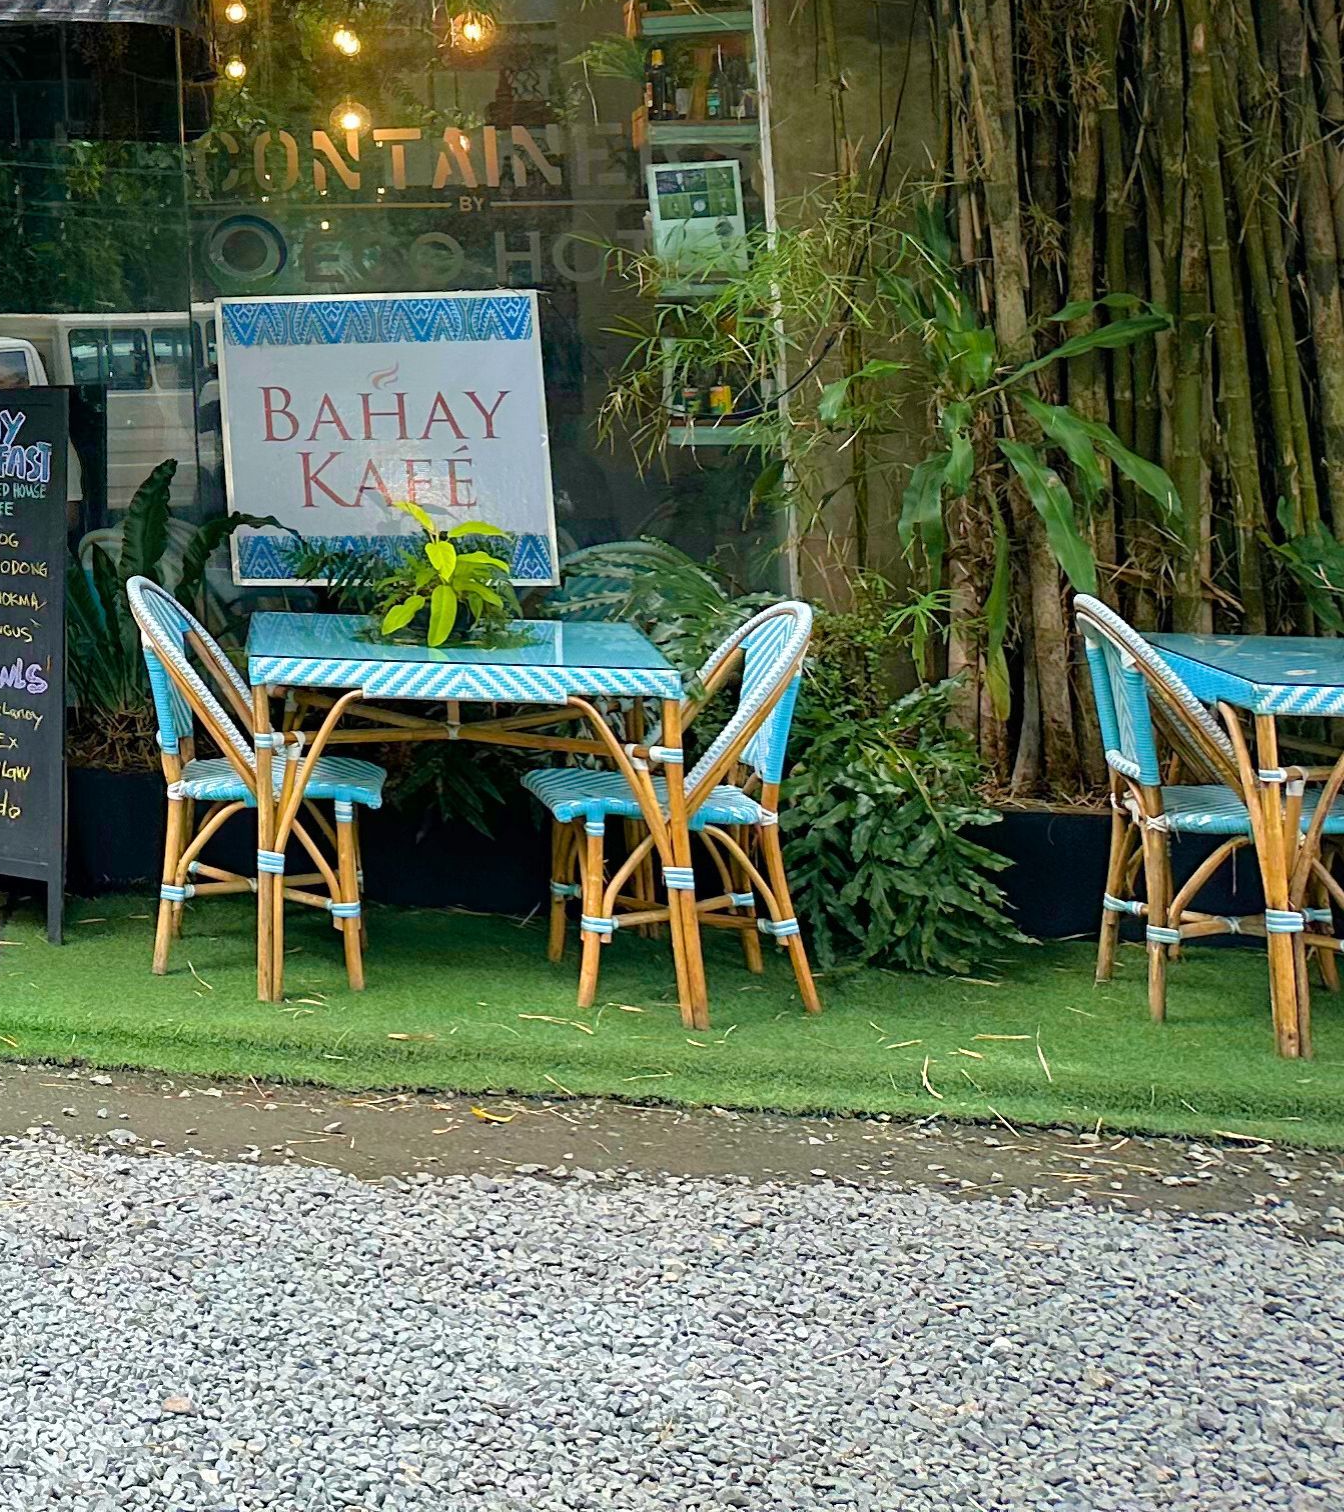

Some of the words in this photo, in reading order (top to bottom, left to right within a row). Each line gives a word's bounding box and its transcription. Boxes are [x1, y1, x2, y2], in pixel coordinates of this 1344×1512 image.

[194, 123, 628, 192] CONTAINE
[459, 196, 485, 212] BY
[258, 386, 511, 442] BAHAY
[12, 483, 47, 499] HOUSE
[297, 445, 478, 509] KAFÉ
